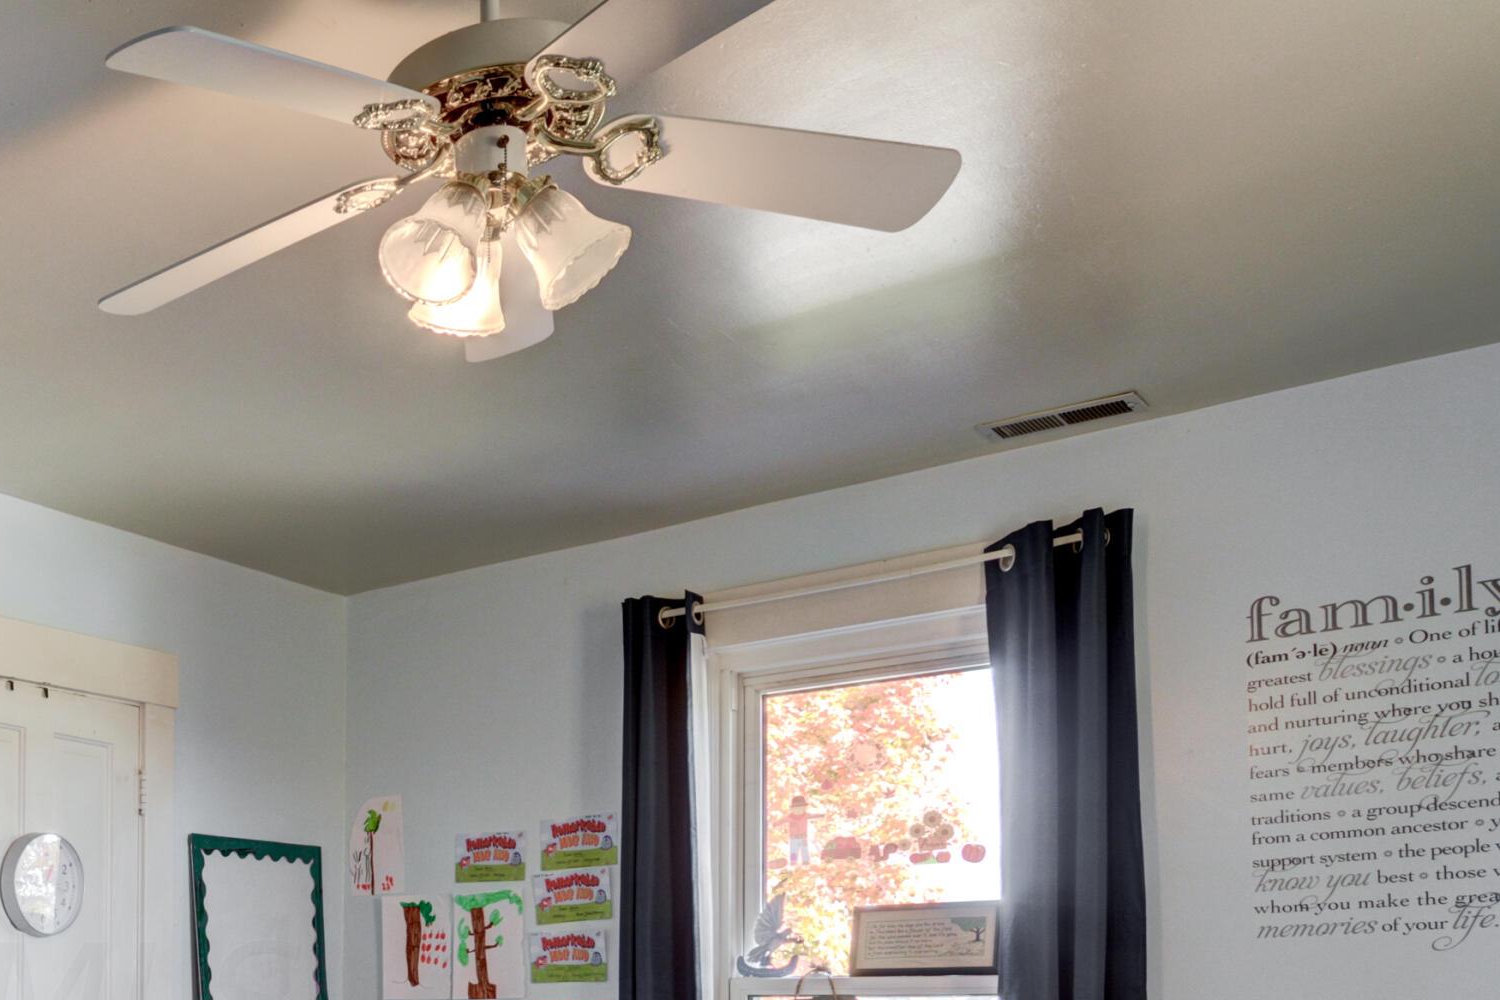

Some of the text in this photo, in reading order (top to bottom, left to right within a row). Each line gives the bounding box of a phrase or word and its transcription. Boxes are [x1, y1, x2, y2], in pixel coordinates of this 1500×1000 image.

[1342, 639, 1389, 654] noun
[1408, 629, 1452, 645] One
[1458, 621, 1480, 638] of
[1247, 672, 1312, 693] greatest
[1314, 652, 1433, 690] blessings
[1452, 654, 1464, 664] a
[1248, 694, 1285, 712] hold
[1290, 690, 1317, 708] full
[1322, 688, 1342, 703] of
[1344, 672, 1470, 700] unconditional
[1247, 717, 1279, 734] and
[1284, 709, 1369, 729] nurturing
[1374, 703, 1432, 721] where
[1437, 699, 1472, 716] you
[1249, 744, 1293, 757] hurt,
[1289, 734, 1357, 764] joys,
[1250, 745, 1497, 780] fears members who share
[1250, 762, 1487, 805] same values, beliefs,
[1251, 809, 1331, 826] traditions
[1351, 808, 1362, 818] a
[1366, 801, 1421, 821] group
[1252, 830, 1291, 845] from
[1295, 832, 1306, 843] a
[1310, 827, 1386, 841] common
[1390, 819, 1468, 835] ancestor
[62, 864, 68, 876] 2
[1252, 855, 1314, 871] support
[1319, 850, 1378, 867] system
[1398, 843, 1426, 858] the
[1431, 838, 1491, 860] people
[1252, 863, 1320, 893] know
[1314, 871, 1372, 904] you
[1377, 869, 1416, 885] best
[1436, 865, 1487, 881] those
[1253, 899, 1310, 914] whom
[1314, 902, 1351, 916] you
[1358, 893, 1410, 909] make
[1417, 891, 1448, 906] the
[1256, 918, 1379, 939] memories
[1381, 918, 1402, 932] of
[1403, 920, 1449, 935] your
